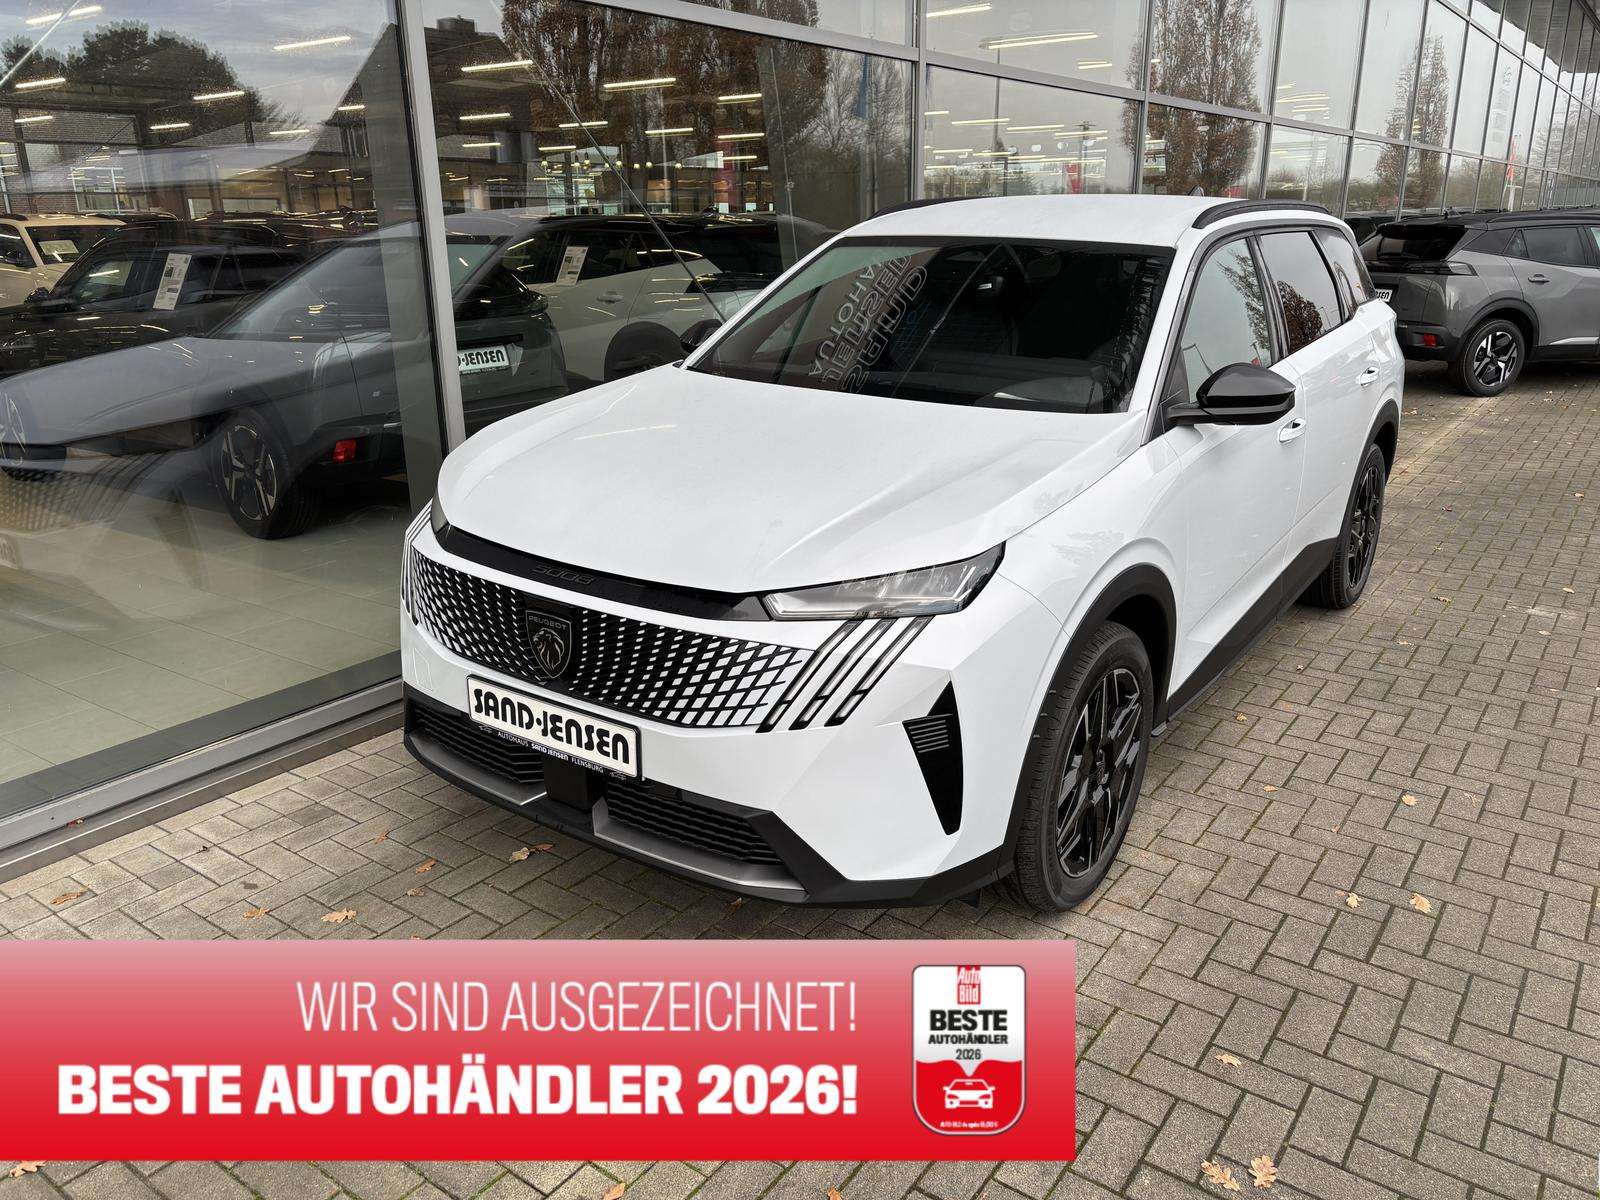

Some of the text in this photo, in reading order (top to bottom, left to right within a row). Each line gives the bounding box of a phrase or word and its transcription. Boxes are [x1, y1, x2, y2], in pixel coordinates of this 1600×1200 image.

[532, 564, 596, 585] 5008
[528, 615, 568, 630] PEUGEOT
[497, 731, 529, 747] AUTOHAUS
[571, 756, 604, 774] FLENSBURG
